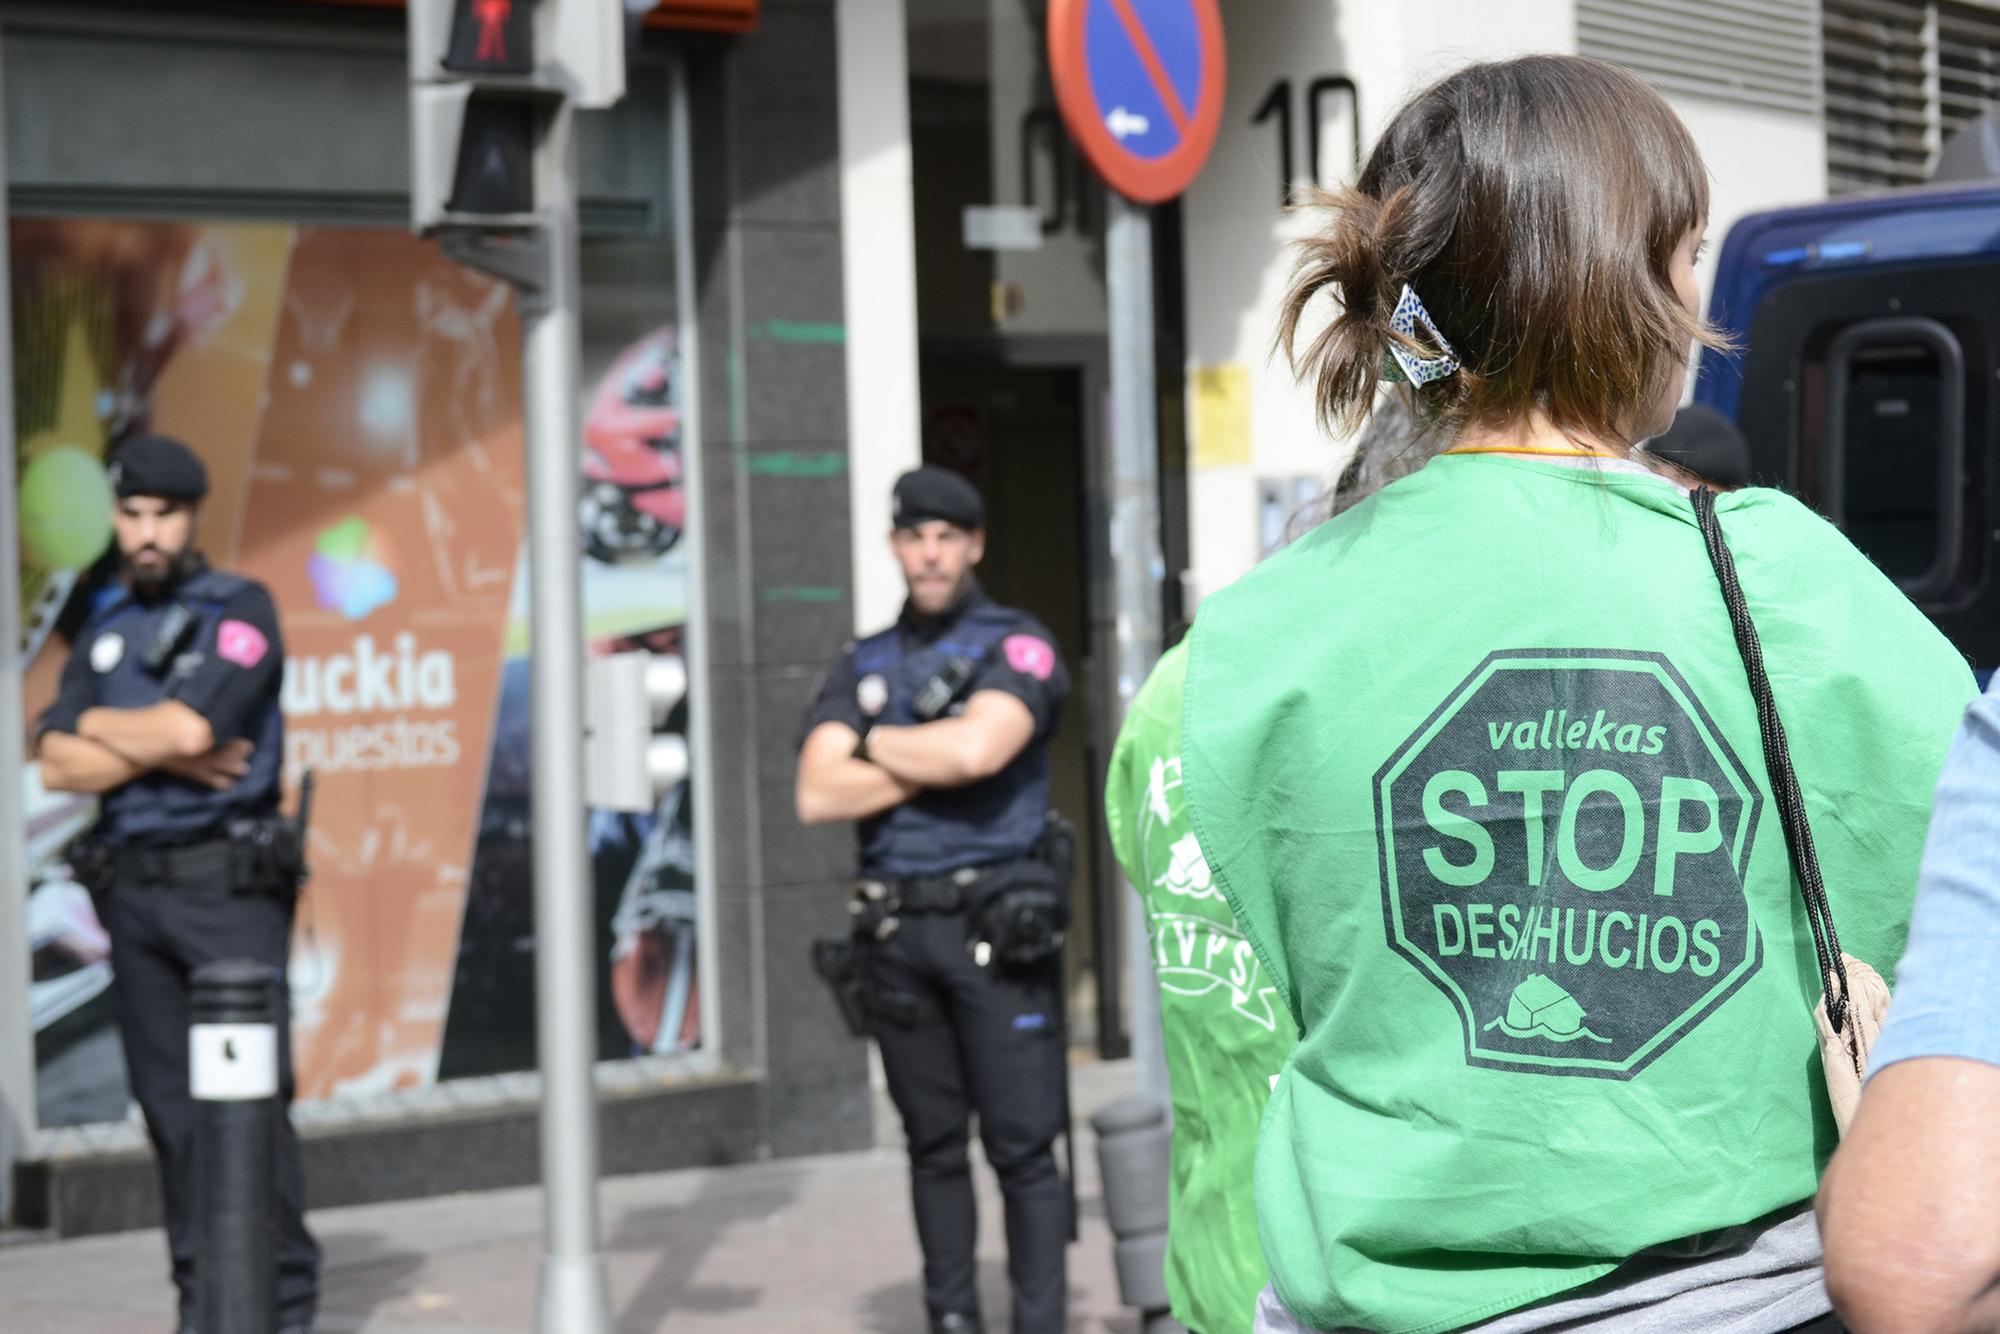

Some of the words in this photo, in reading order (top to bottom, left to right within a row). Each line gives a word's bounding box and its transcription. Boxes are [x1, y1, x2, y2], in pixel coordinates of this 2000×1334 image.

[280, 630, 456, 714] uckia
[1488, 709, 1667, 755] vallekas
[1422, 769, 1723, 897] STOP
[1432, 903, 1722, 977] DESAHUCIOS
